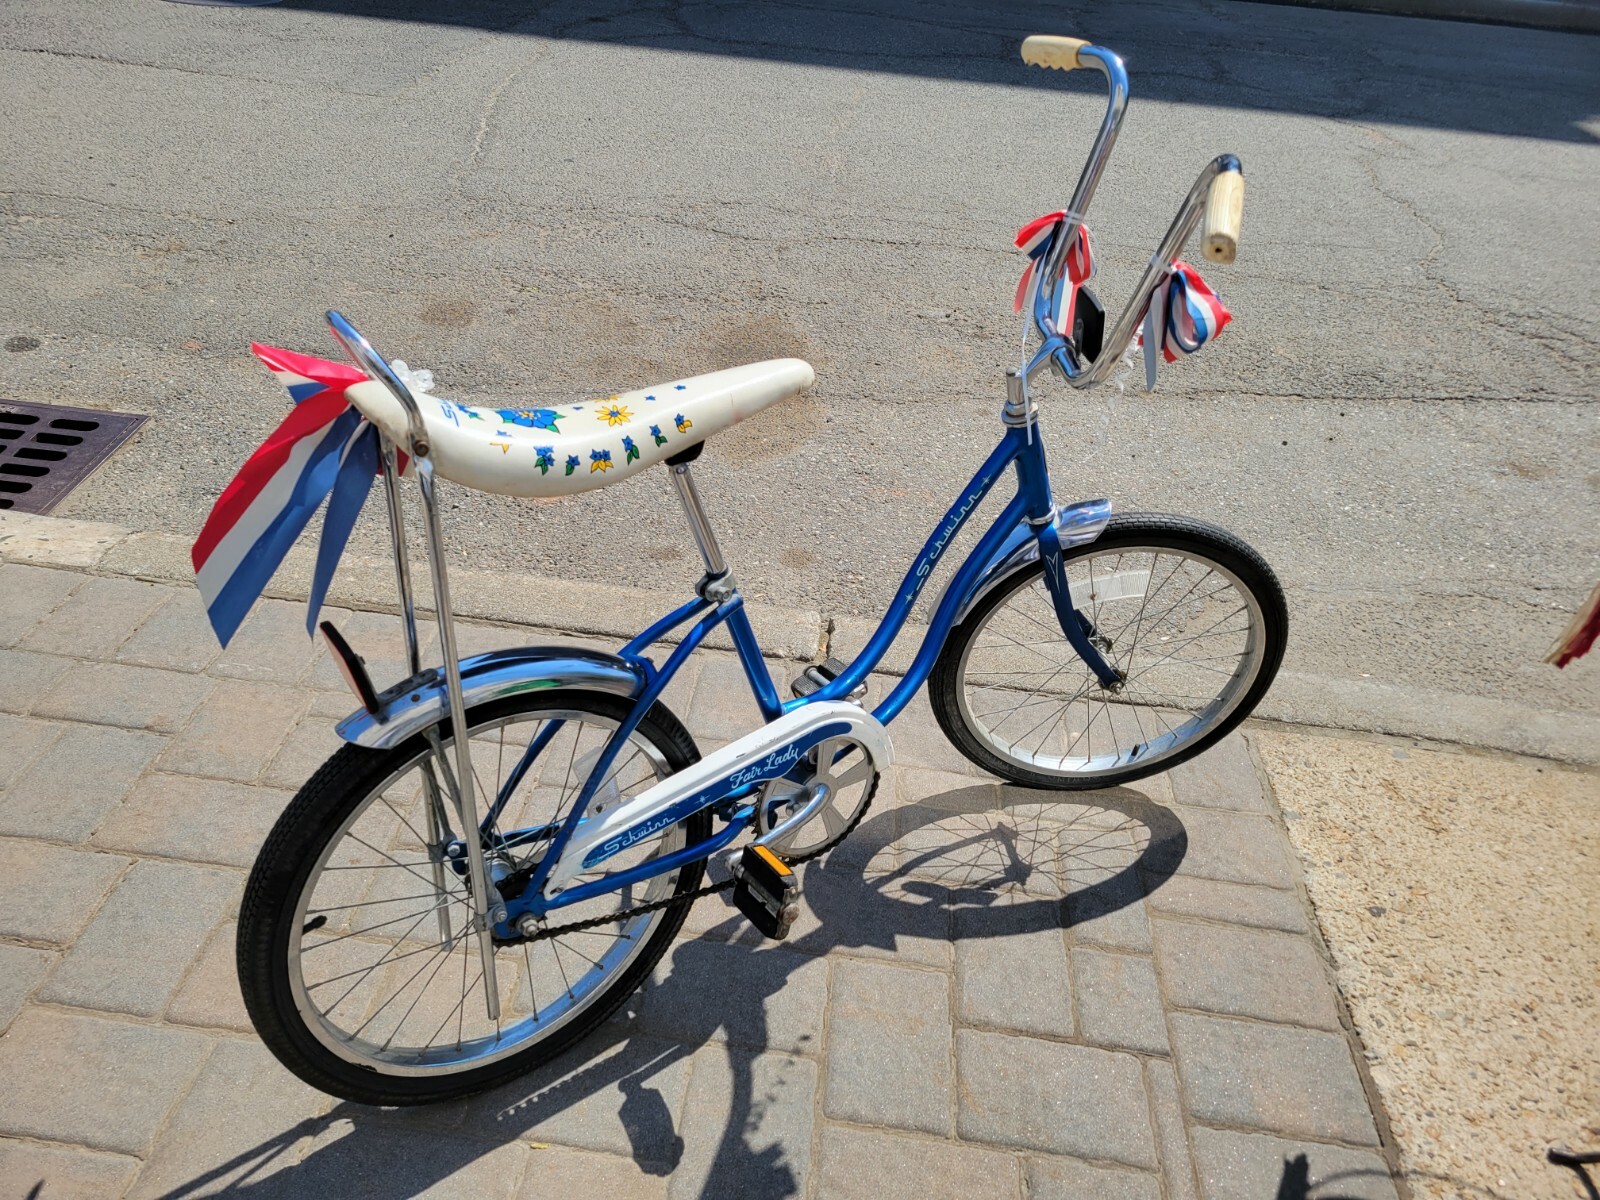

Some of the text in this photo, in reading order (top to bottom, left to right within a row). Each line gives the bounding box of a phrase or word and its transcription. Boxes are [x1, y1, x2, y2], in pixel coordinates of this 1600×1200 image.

[916, 489, 983, 591] Schwinn
[729, 743, 799, 789] Fair Lady
[594, 816, 676, 860] Schwinn
